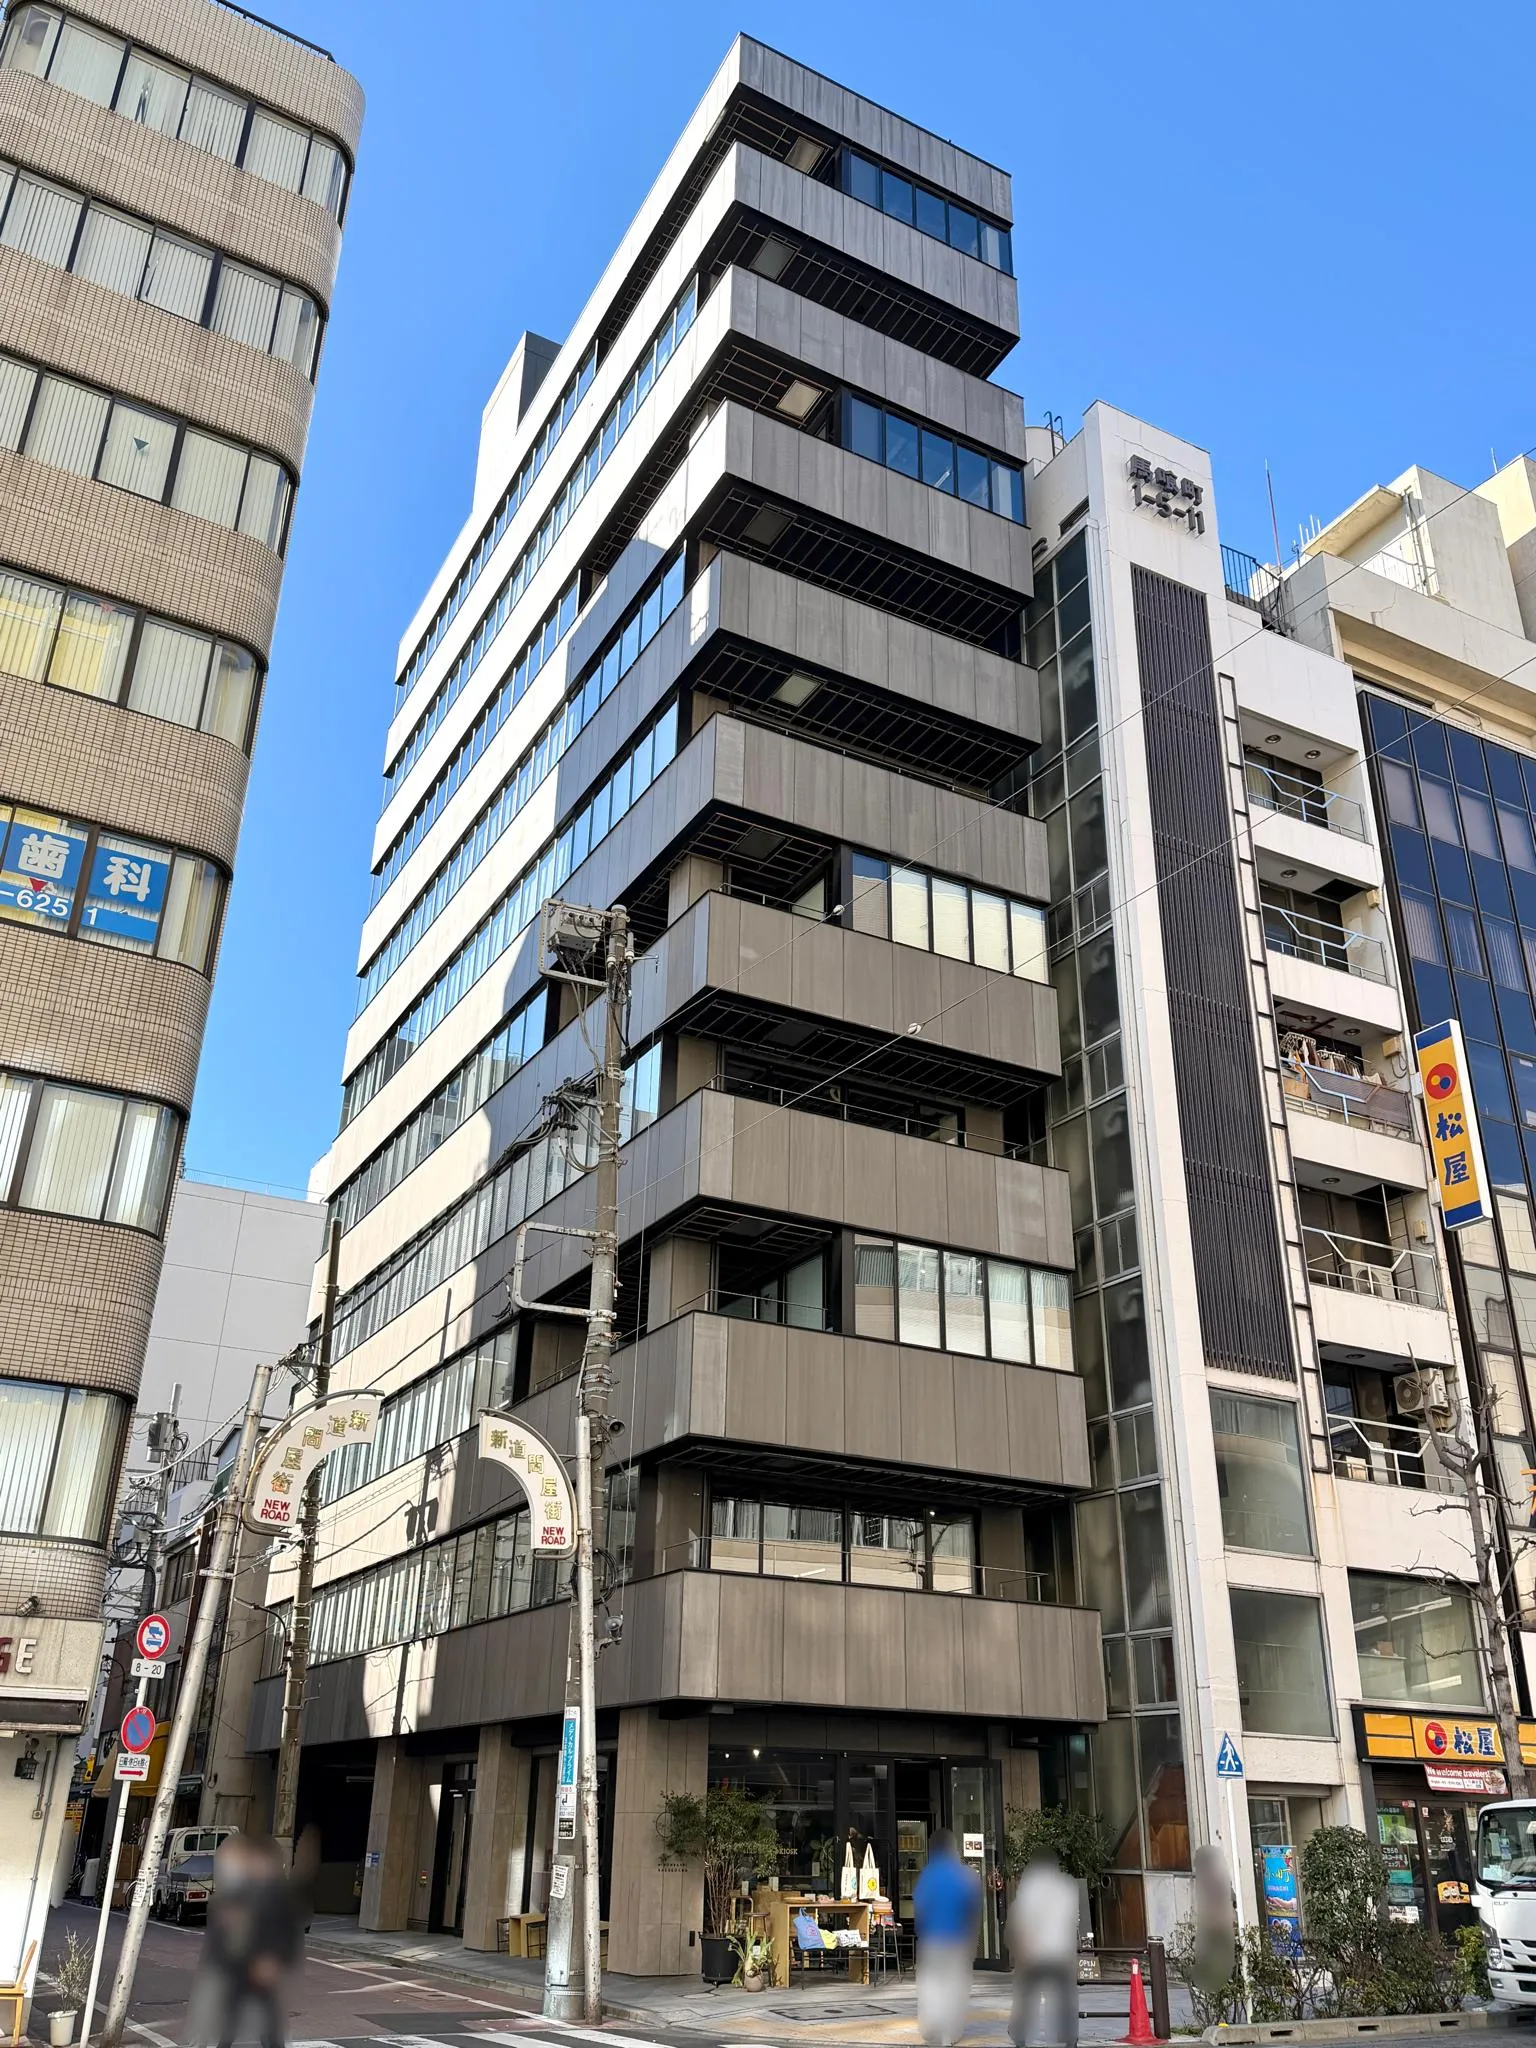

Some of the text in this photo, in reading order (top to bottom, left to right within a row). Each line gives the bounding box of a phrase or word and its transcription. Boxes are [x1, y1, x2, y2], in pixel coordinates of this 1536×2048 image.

[1132, 482, 1205, 535] 1-5-11
[17, 832, 152, 902] 歯科
[1435, 1112, 1470, 1186] 松屋
[270, 1409, 371, 1495] 新道問屋街
[490, 1429, 562, 1520] 新道問屋街
[260, 1509, 291, 1522] ROAD
[264, 1499, 291, 1511] NEW
[541, 1536, 566, 1545] ROAD
[542, 1526, 565, 1536] NEW
[1454, 1726, 1496, 1756] 松屋
